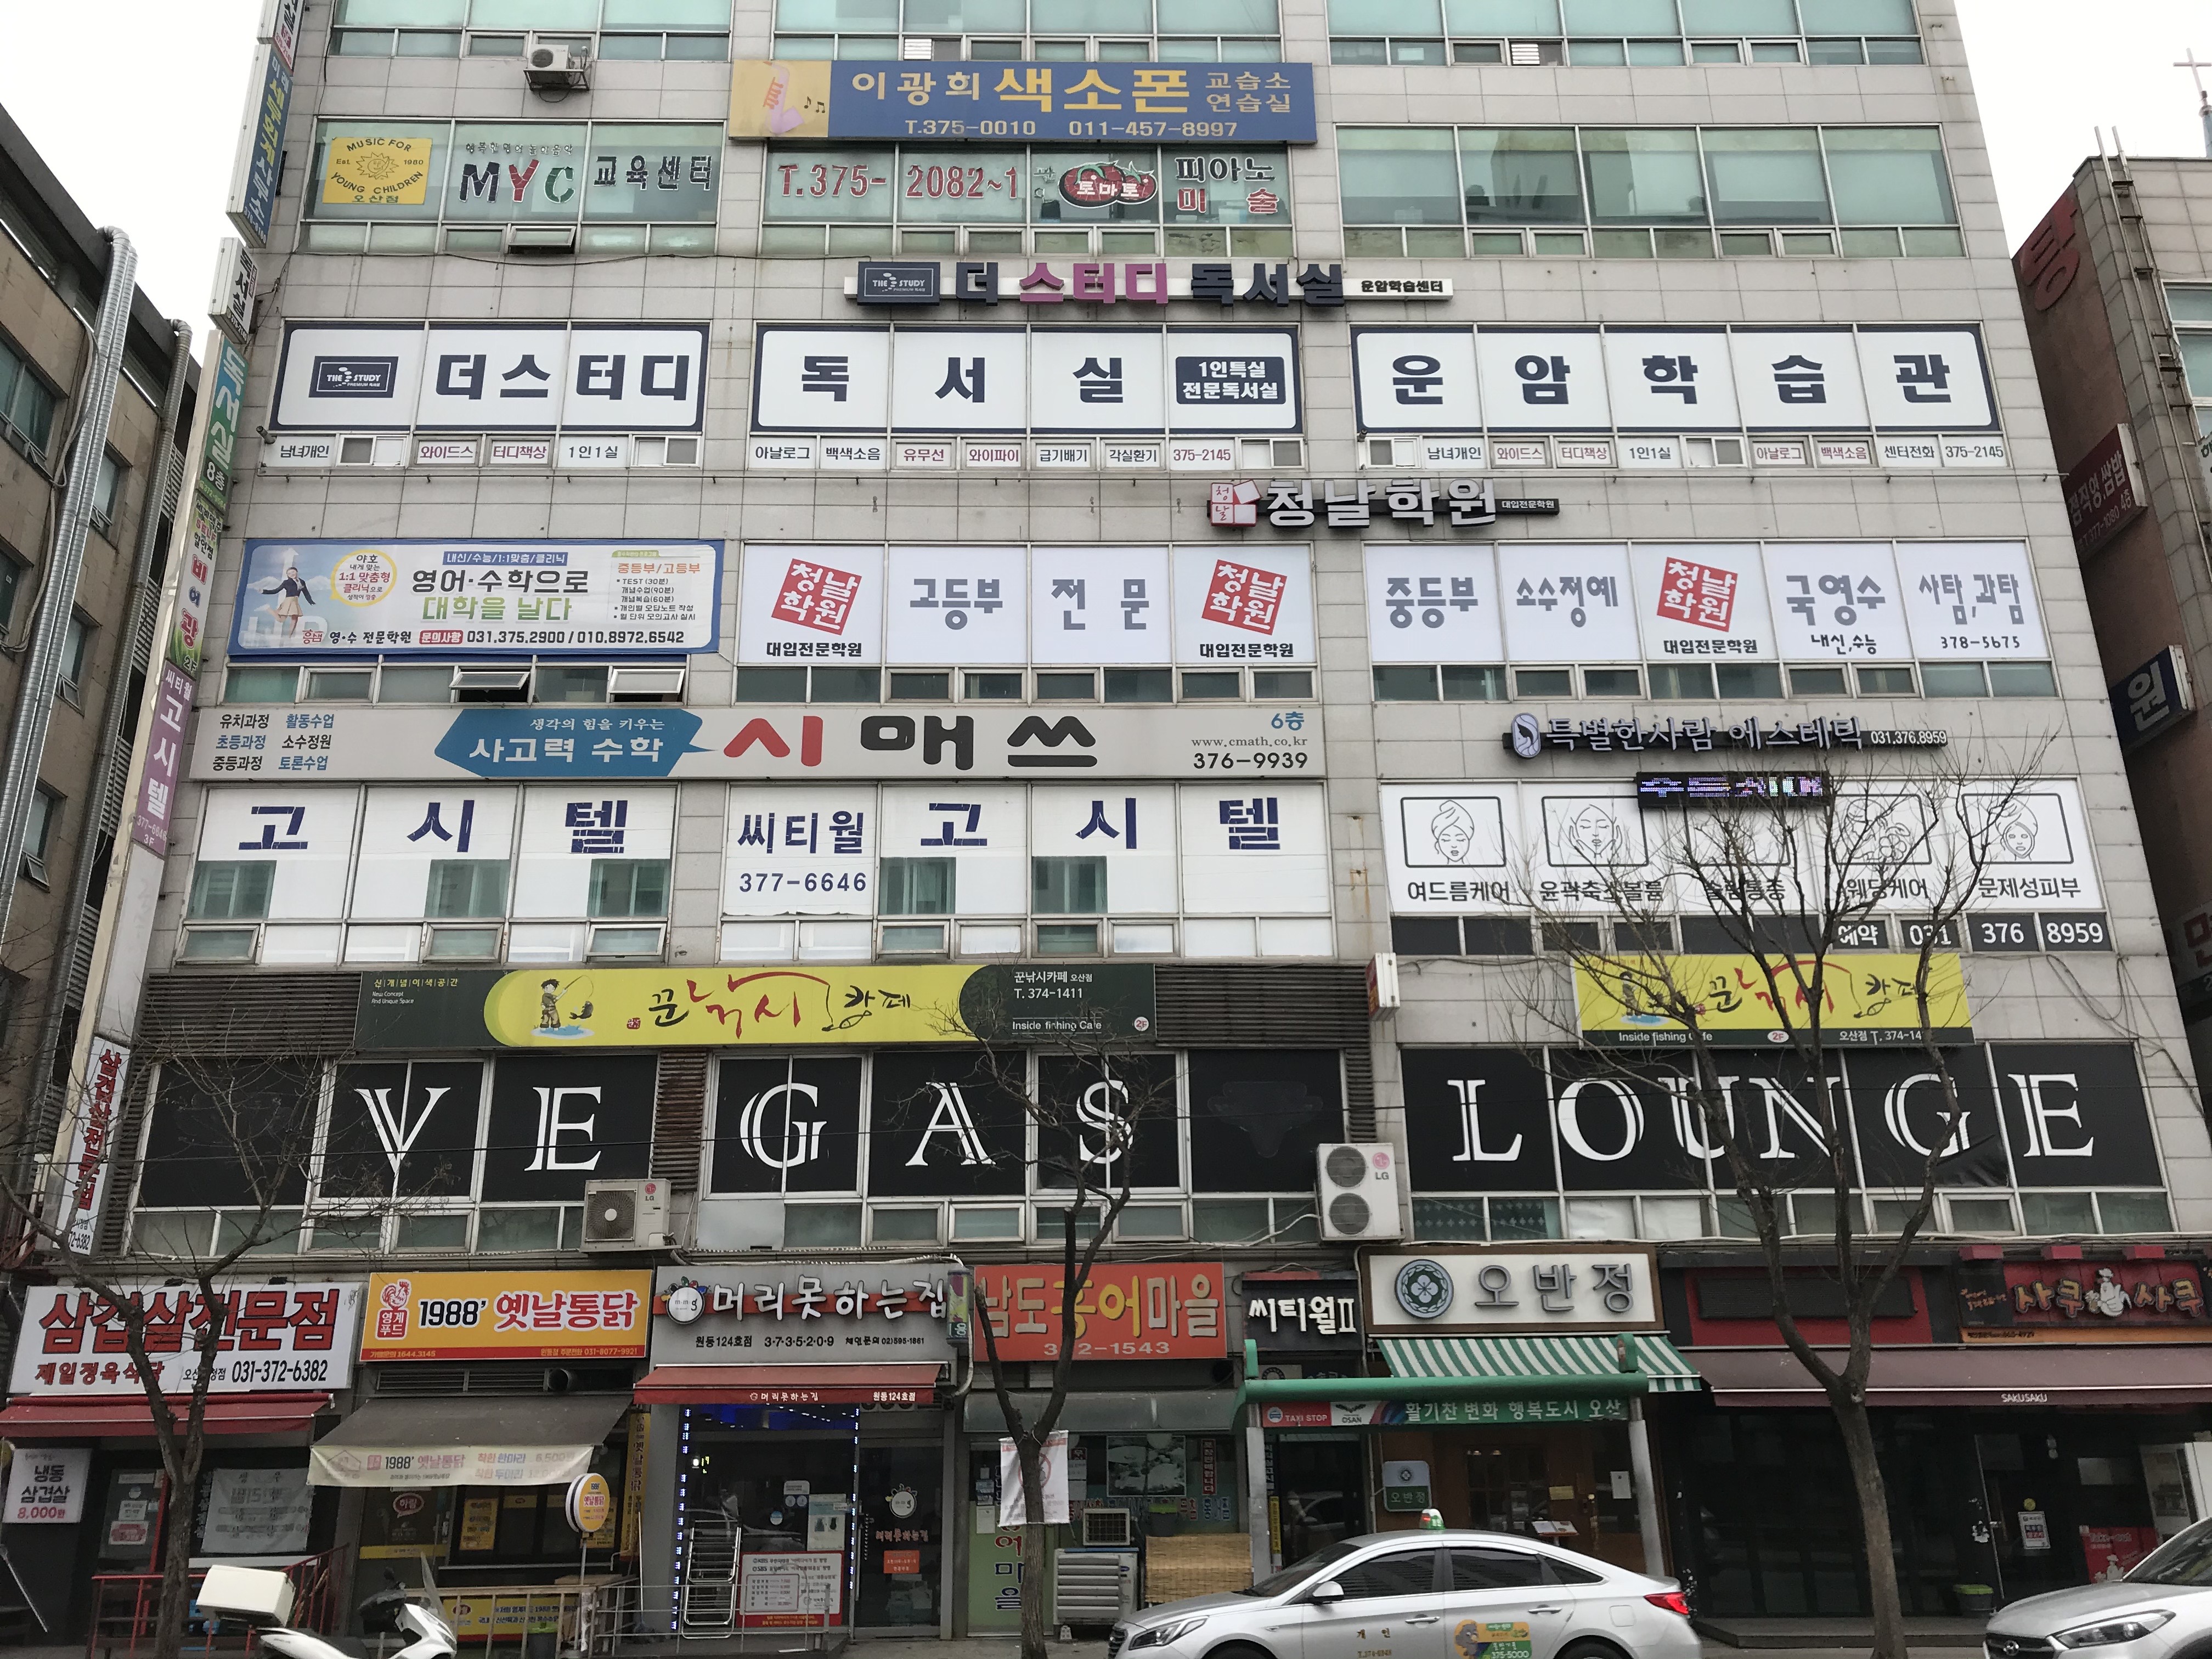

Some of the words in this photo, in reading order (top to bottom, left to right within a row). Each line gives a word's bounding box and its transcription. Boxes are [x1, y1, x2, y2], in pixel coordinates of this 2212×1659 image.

[1205, 71, 1290, 91] 교습소
[852, 70, 980, 105] 이광희
[994, 67, 1191, 114] 색소폰
[1205, 92, 1291, 114] 연습실
[905, 120, 1036, 136] T.375-0010
[1069, 120, 1238, 137] 011-457-8997
[347, 137, 386, 153] MUSIC
[387, 138, 412, 153] FOR
[465, 142, 498, 155] 행복한
[592, 155, 713, 191] 교육센터
[1174, 156, 1276, 184] 피아노
[330, 171, 365, 194] YOUNG
[373, 171, 424, 194] CHILDREN
[458, 159, 575, 204] MYC
[777, 163, 887, 199] T.375-
[905, 163, 1019, 200] 2082~1
[1077, 180, 1139, 198] 토마토
[352, 194, 399, 204] 오산점
[873, 279, 888, 287] THE
[899, 279, 926, 287] STUDY
[956, 262, 998, 306] 더
[1019, 262, 1167, 305] 스터디
[1191, 262, 1345, 307] 독서실
[1360, 279, 1444, 294] 운암학습센터
[353, 374, 381, 382] STUDY
[436, 354, 690, 400] 더스터디
[1198, 361, 1266, 379] 1인특실
[1182, 381, 1278, 400] 전문독서실
[280, 444, 329, 459] 남녀개인
[420, 445, 473, 459] 와이드스
[493, 445, 546, 460] 터디책상
[569, 445, 618, 459] 1인1실
[755, 445, 810, 462] 아날로그
[825, 445, 881, 462] 백색소음
[902, 447, 944, 463] 유무선
[969, 448, 1019, 463] 와이파이
[1039, 448, 1088, 464] 급기배기
[1108, 448, 1158, 464] 각실환기
[1172, 448, 1231, 461] 375-2145
[1426, 446, 1482, 461] 남녀개인
[1496, 447, 1544, 462] 와이드스
[1561, 447, 1607, 462] 터디책상
[1629, 447, 1671, 461] 1인1실
[1756, 446, 1803, 462] 아날로그
[1820, 445, 1867, 461] 백색소음
[1883, 445, 1936, 461] 센터전화
[1945, 445, 2004, 459] 375-2145
[1267, 479, 1497, 528] 청날학원
[1502, 500, 1555, 509] 대입전문학원
[356, 554, 378, 564] 야호
[618, 563, 701, 574] 중등부/고등부
[339, 572, 355, 580] 1:1
[358, 572, 391, 583] 맞춤형
[343, 584, 383, 594] 클리닉으로
[421, 596, 506, 621] 대학을
[518, 597, 572, 621] 날다
[910, 578, 1003, 630] 고등부
[1386, 578, 1479, 629] 중등부
[1516, 577, 1618, 627] 소수정예
[1787, 575, 1886, 627] 국영수
[363, 630, 411, 644] 전문학원
[421, 631, 461, 643] 문의사항
[467, 630, 565, 644] 031.375.2900
[577, 631, 685, 644] 010.8972.6542
[1940, 636, 2021, 650] 378-5675
[766, 642, 862, 658] 대입전문학원
[1200, 643, 1294, 658] 대입전문학원
[1663, 639, 1758, 654] 대입전문학원
[219, 713, 270, 730] 유치과정
[285, 713, 335, 730] 활동수업
[529, 718, 575, 731] 생각의
[582, 718, 615, 731] 힘을
[619, 717, 665, 731] 키우는
[1271, 713, 1305, 731] 6층
[216, 734, 267, 750] 초등과정
[281, 734, 332, 750] 소수정원
[723, 715, 1097, 770] 시매쓰
[1191, 737, 1308, 749] www.cmath.co.kr
[1546, 716, 1716, 753] 특별한사람
[1728, 716, 1863, 752] 에스테틱
[1871, 730, 1948, 746] 031.376.8959
[148, 694, 182, 820] 고시텔
[469, 737, 573, 763] 사고력
[591, 737, 664, 763] 수학
[212, 755, 263, 772] 중등과정
[279, 755, 328, 771] 토론수업
[1193, 752, 1308, 769] 376-9939
[144, 833, 155, 846] 3F
[737, 811, 865, 855] 씨티월
[740, 872, 867, 893] 377-6646
[1846, 878, 1929, 899] 웨딩케어
[1978, 878, 2081, 899] 문제성피부
[1408, 881, 1510, 902] 여드름케어
[1910, 924, 1951, 946] 031
[1982, 923, 2024, 944] 376
[2047, 922, 2103, 944] 8959
[1014, 971, 1068, 984] 꾼낚시카페
[1070, 973, 1093, 983] 오산점
[1028, 988, 1084, 1000] 374-1411
[1012, 1020, 1041, 1031] Inside
[1045, 1020, 1077, 1032] fishing
[1136, 1019, 1148, 1029] 2F
[1619, 1031, 1650, 1042] Inside
[1652, 1031, 1686, 1043] fishing
[1773, 1032, 1784, 1041] 2F
[1839, 1031, 1867, 1042] 오산점
[1475, 1263, 1635, 1313] 오반정
[713, 1274, 947, 1321] 머리못하는집
[382, 1312, 404, 1324] 영계
[496, 1293, 638, 1329] 옛날통닭
[40, 1289, 340, 1354] 삼겹살전문점
[381, 1324, 404, 1336] 푸드
[695, 1335, 752, 1348] 원동124호점
[1044, 1341, 1170, 1356] 32-1543
[232, 1360, 328, 1383] 031-372-6382
[760, 1392, 819, 1402] 머리못하는집
[873, 1392, 916, 1402] 원동124호점
[2001, 1393, 2048, 1403] SAKUSAKU
[1308, 1414, 1328, 1423] STOP
[1405, 1401, 1459, 1422] 활기찬
[1464, 1401, 1499, 1421] 변화
[1508, 1398, 1579, 1419] 행복도시
[1588, 1398, 1622, 1418] 오산
[417, 1454, 466, 1469] 옛날통닭
[34, 1464, 65, 1483] 냉동
[20, 1486, 70, 1504] 삼겹살
